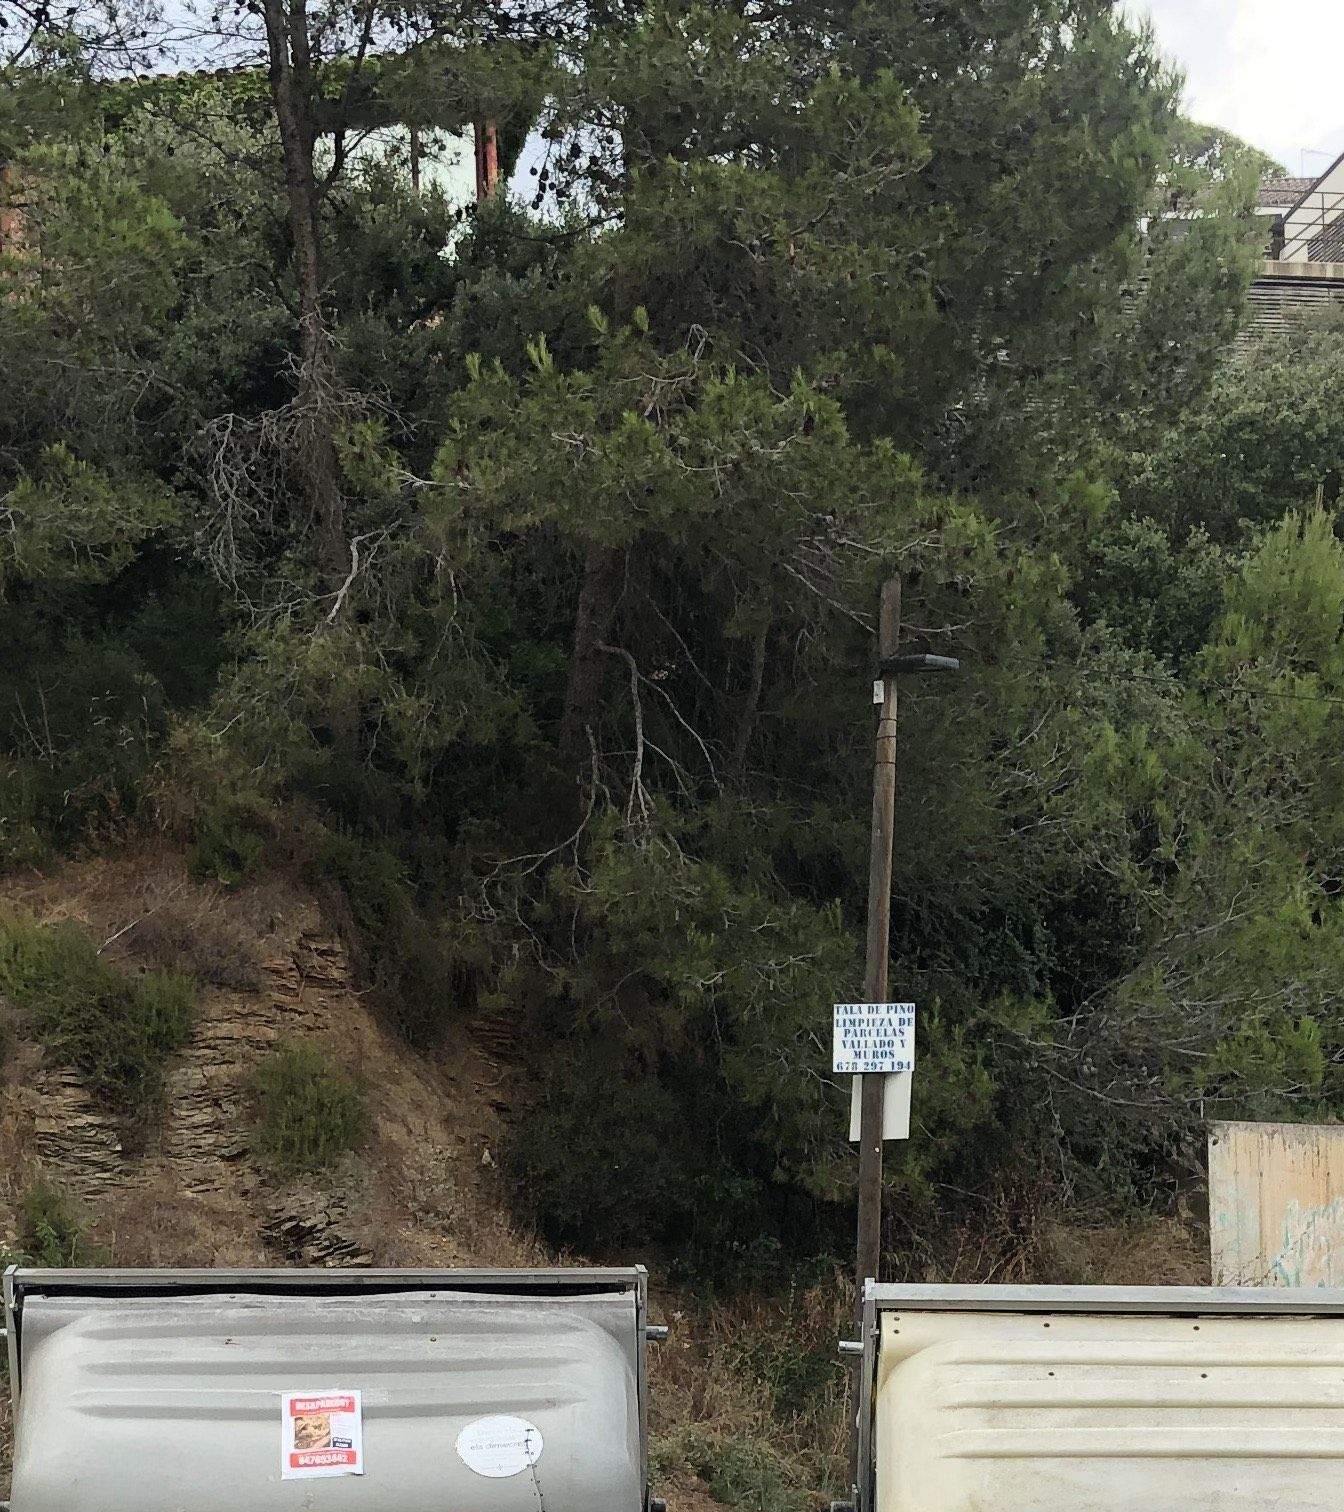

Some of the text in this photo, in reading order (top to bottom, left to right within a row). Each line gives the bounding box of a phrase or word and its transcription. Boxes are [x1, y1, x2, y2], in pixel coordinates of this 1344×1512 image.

[835, 1004, 914, 1015] TALA DE PINO
[835, 1017, 914, 1028] LIMPIEZA DE
[843, 1027, 905, 1038] PARCELAS
[841, 1039, 907, 1049] VALLADO Y
[853, 1050, 895, 1060] MUROS
[863, 1061, 885, 1071] 297
